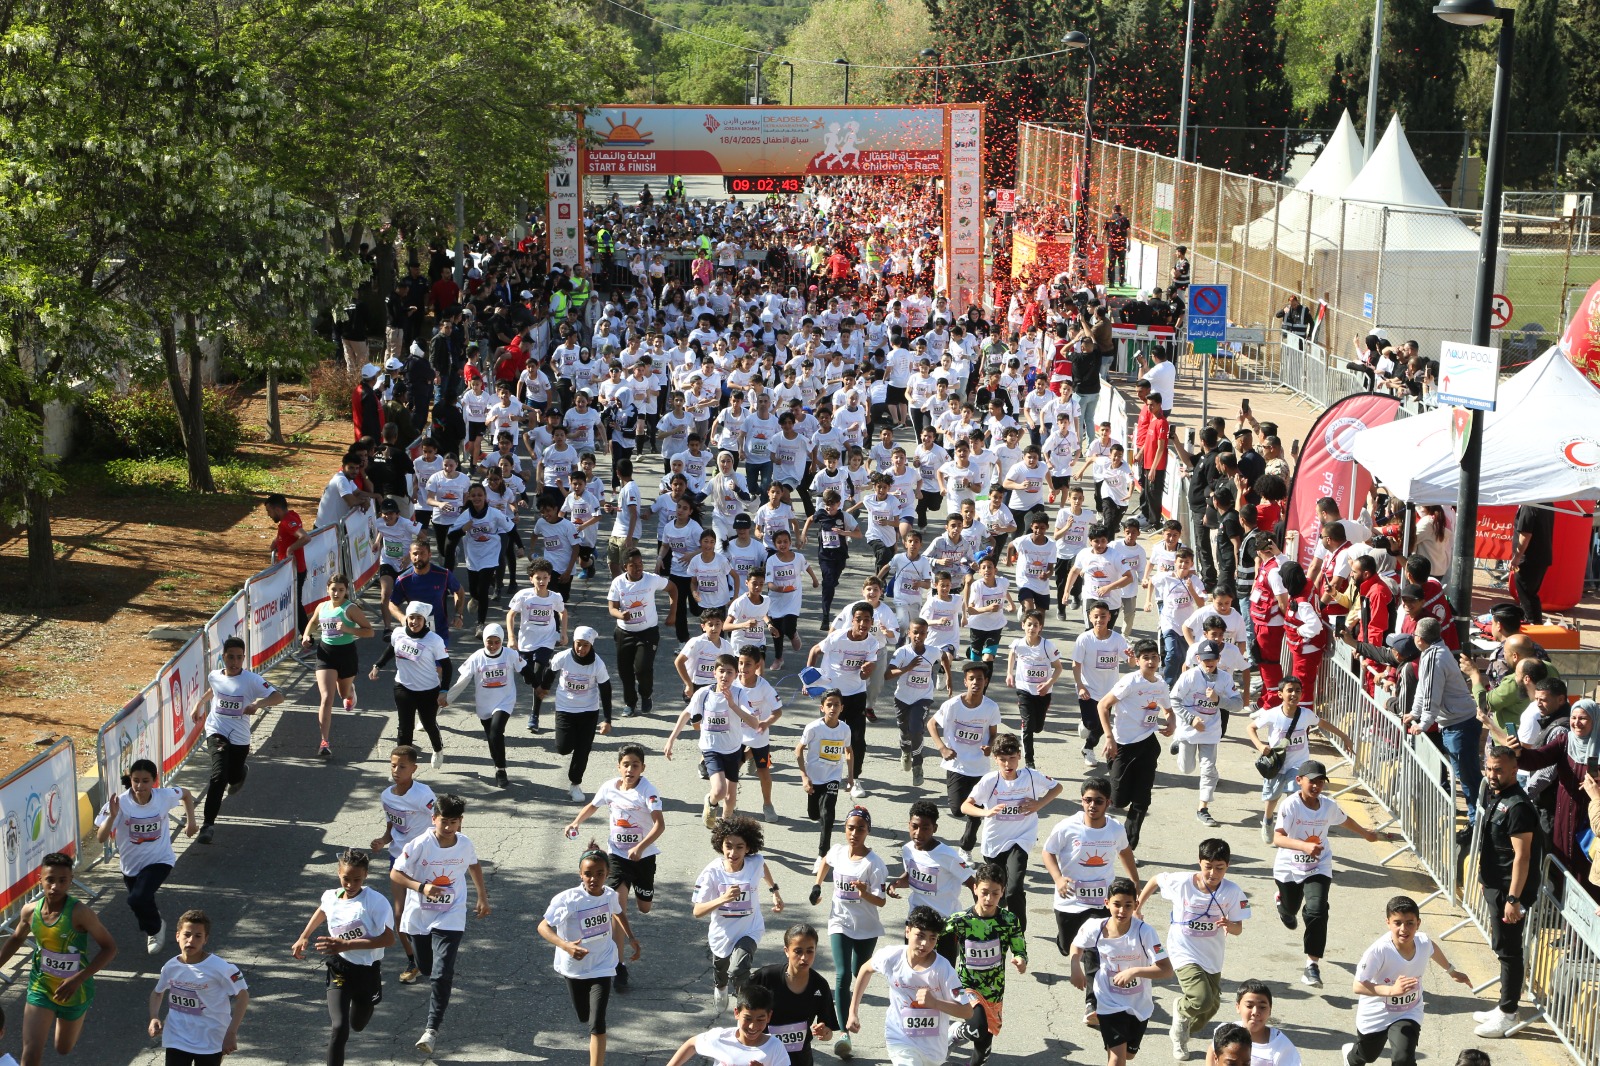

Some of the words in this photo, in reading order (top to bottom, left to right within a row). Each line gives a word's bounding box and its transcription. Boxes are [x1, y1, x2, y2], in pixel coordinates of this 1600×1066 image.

[720, 136, 761, 144] 18/4/2025
[763, 134, 789, 145] الأطفال
[790, 135, 809, 146] سباق
[589, 151, 626, 162] والنهاية
[627, 151, 656, 161] البداية
[589, 163, 617, 172] START
[619, 163, 626, 172] &
[628, 163, 656, 172] FINISH
[915, 161, 939, 170] Race
[1446, 348, 1469, 361] AQUA
[1470, 351, 1493, 364] POOL
[776, 569, 793, 577] 9310
[629, 611, 643, 619] 178
[401, 644, 420, 656] 9139
[700, 664, 714, 672] 918
[485, 669, 505, 678] 9155
[1026, 669, 1045, 678] 9248
[910, 675, 928, 684] 9254
[219, 699, 241, 711] 9378
[958, 732, 979, 741] 9170
[1289, 736, 1303, 746] 144
[133, 821, 161, 834] 9123
[616, 833, 639, 843] 9362
[912, 868, 932, 884] 9174
[1079, 887, 1104, 897] 9119
[584, 913, 608, 928] 9396
[1188, 921, 1214, 931] 9253
[970, 947, 995, 959] 9111
[45, 957, 74, 971] 9347
[171, 994, 196, 1008] 9130
[1391, 992, 1417, 1006] 9102
[907, 1016, 935, 1029] 9344
